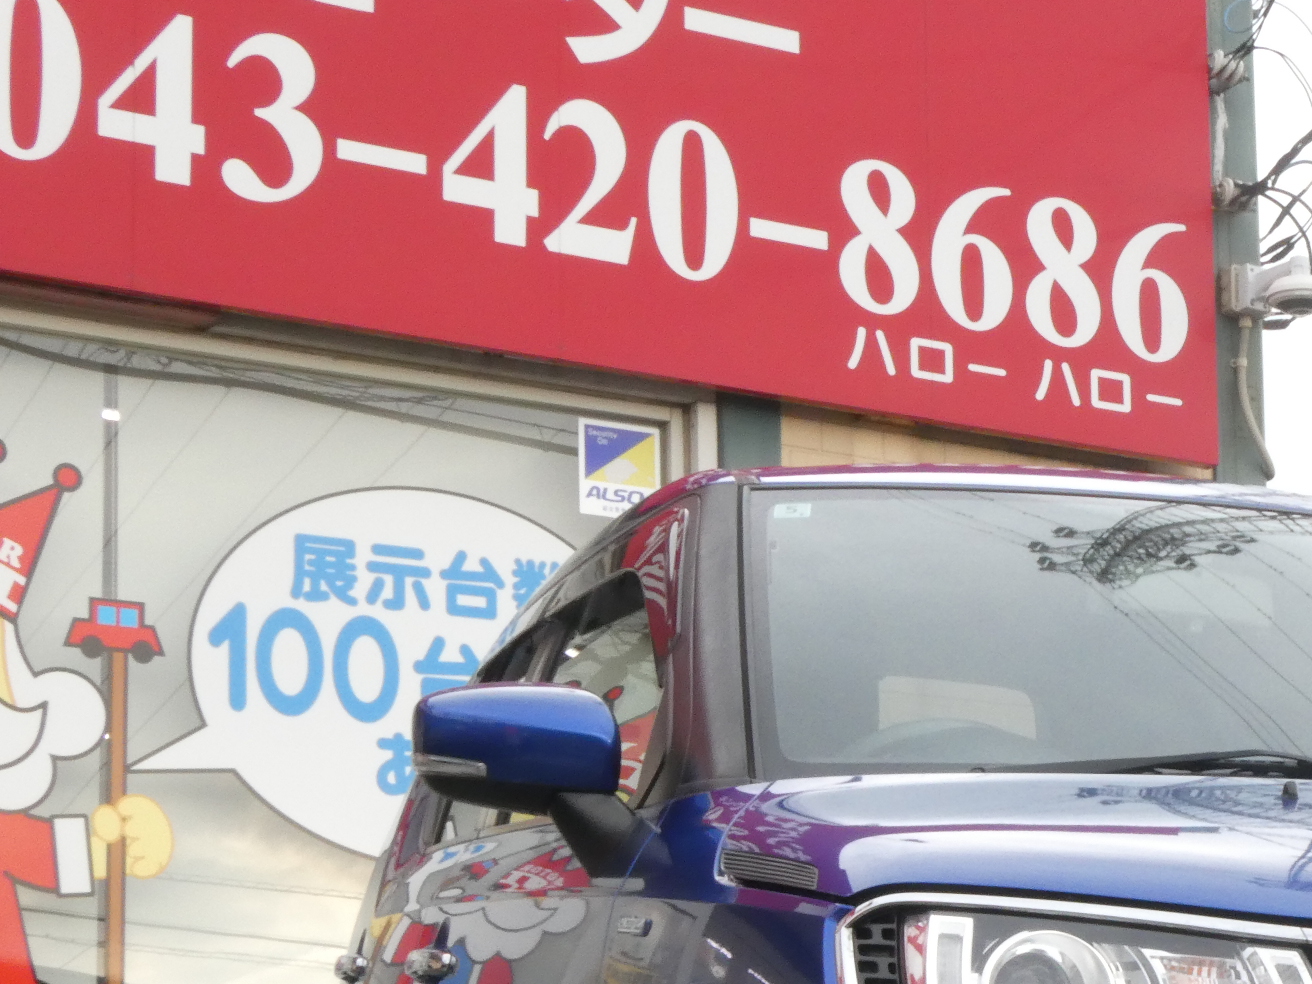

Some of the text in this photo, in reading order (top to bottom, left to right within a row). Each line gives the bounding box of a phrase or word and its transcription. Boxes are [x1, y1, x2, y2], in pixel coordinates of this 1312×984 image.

[848, 325, 1183, 413] ハロー ハロー
